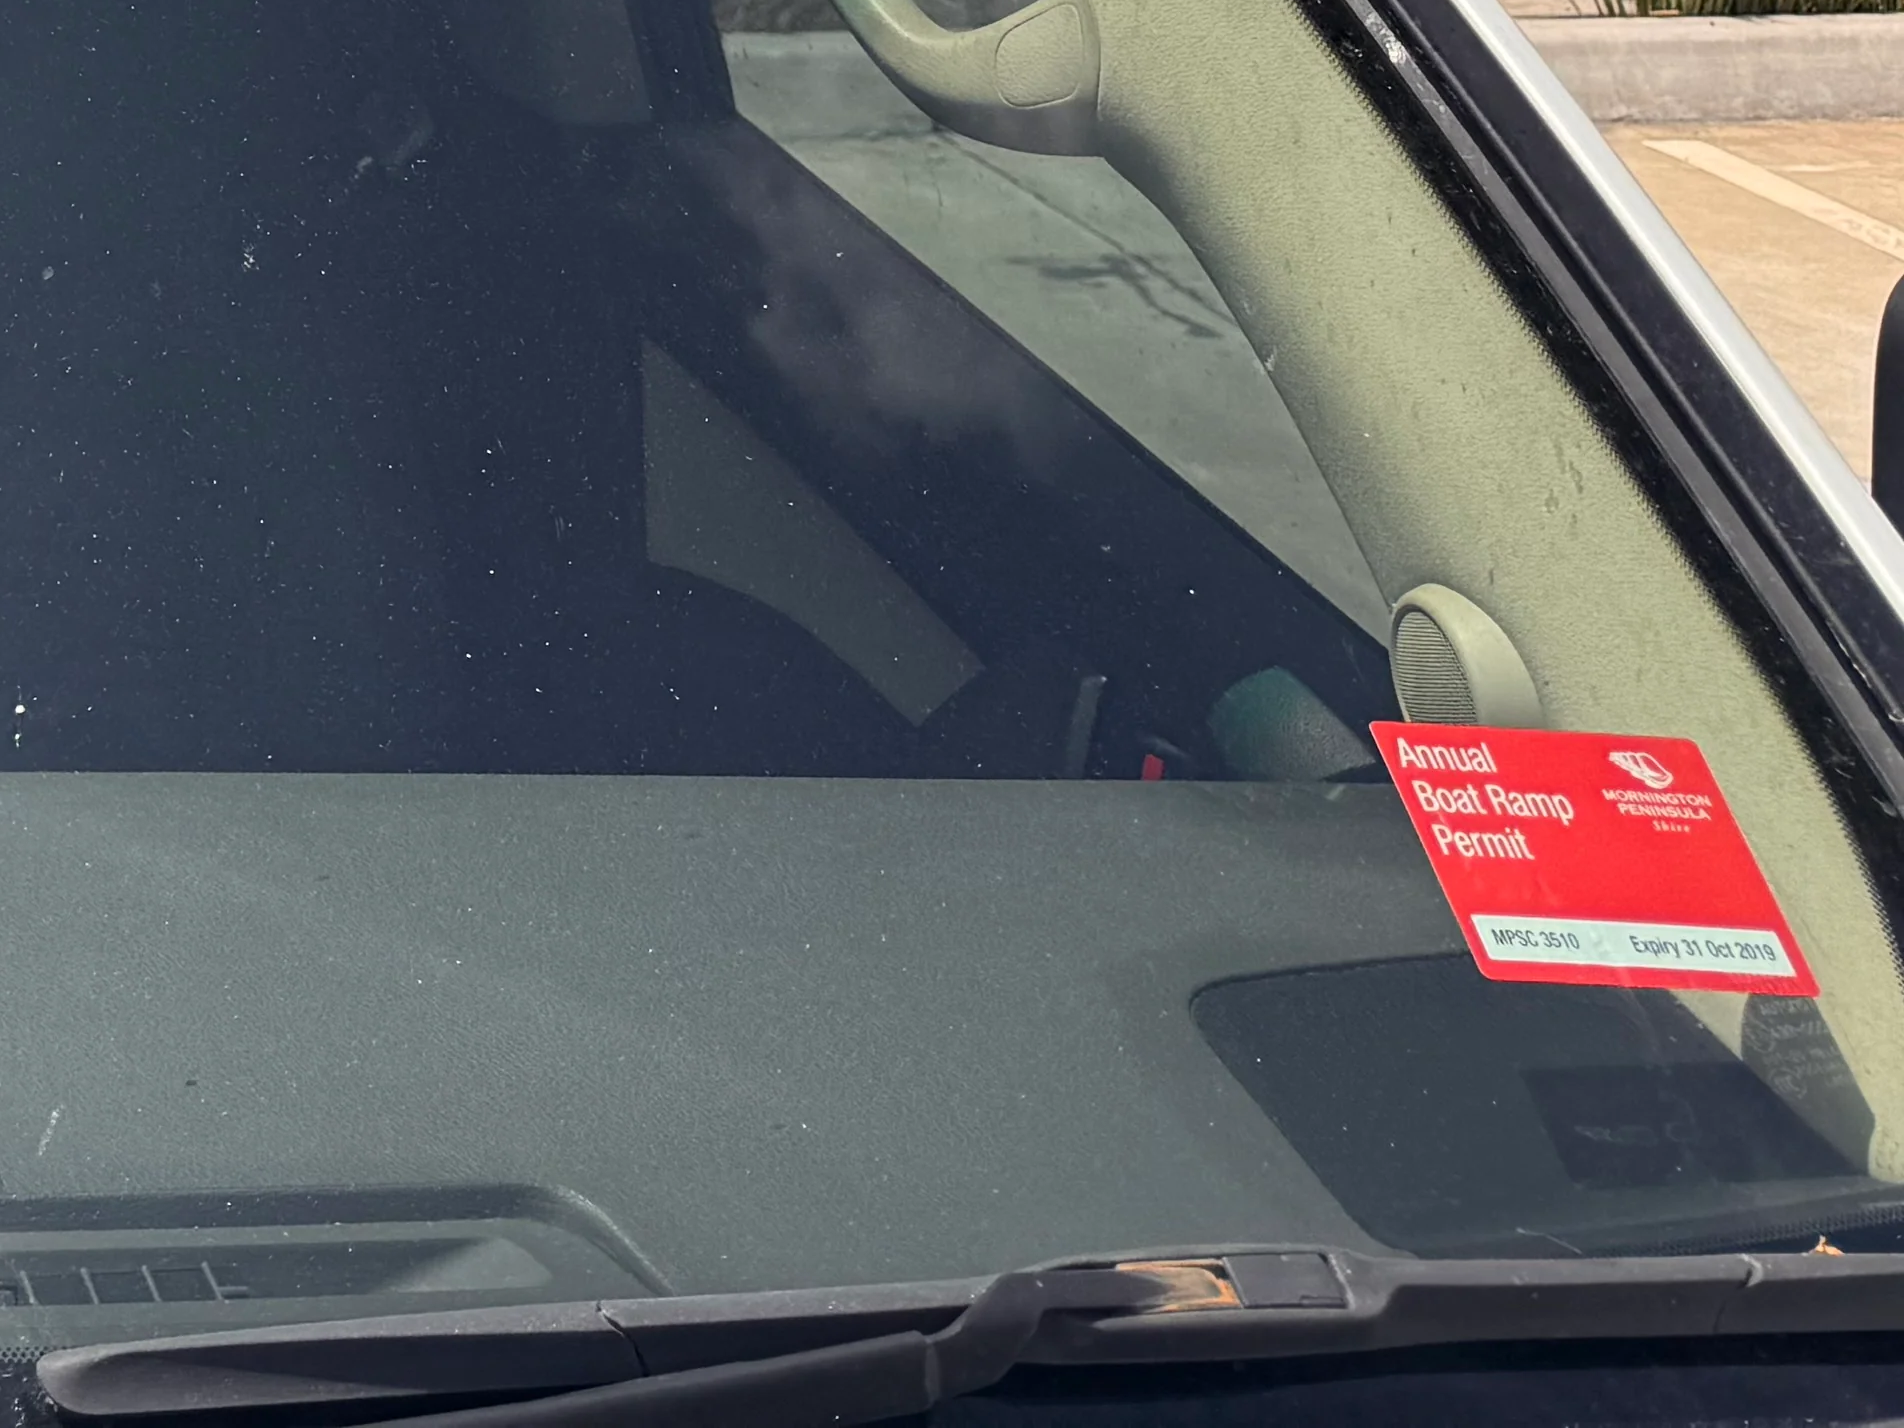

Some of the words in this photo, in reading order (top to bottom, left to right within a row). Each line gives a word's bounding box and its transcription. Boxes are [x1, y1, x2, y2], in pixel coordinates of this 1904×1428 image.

[1395, 737, 1497, 774] Annual
[1411, 780, 1488, 817] Boat
[1486, 784, 1575, 826] Ramp
[1601, 789, 1713, 807] MORNINGTON
[1616, 803, 1712, 821] PENINSULA
[1652, 820, 1691, 832] Shire
[1432, 824, 1535, 861] Permit
[1490, 928, 1539, 950] MPSC
[1541, 932, 1580, 951] 3510
[1628, 935, 1679, 958] Expiry
[1683, 938, 1703, 957] 31
[1706, 939, 1734, 959] Oct
[1734, 941, 1777, 962] 2019
